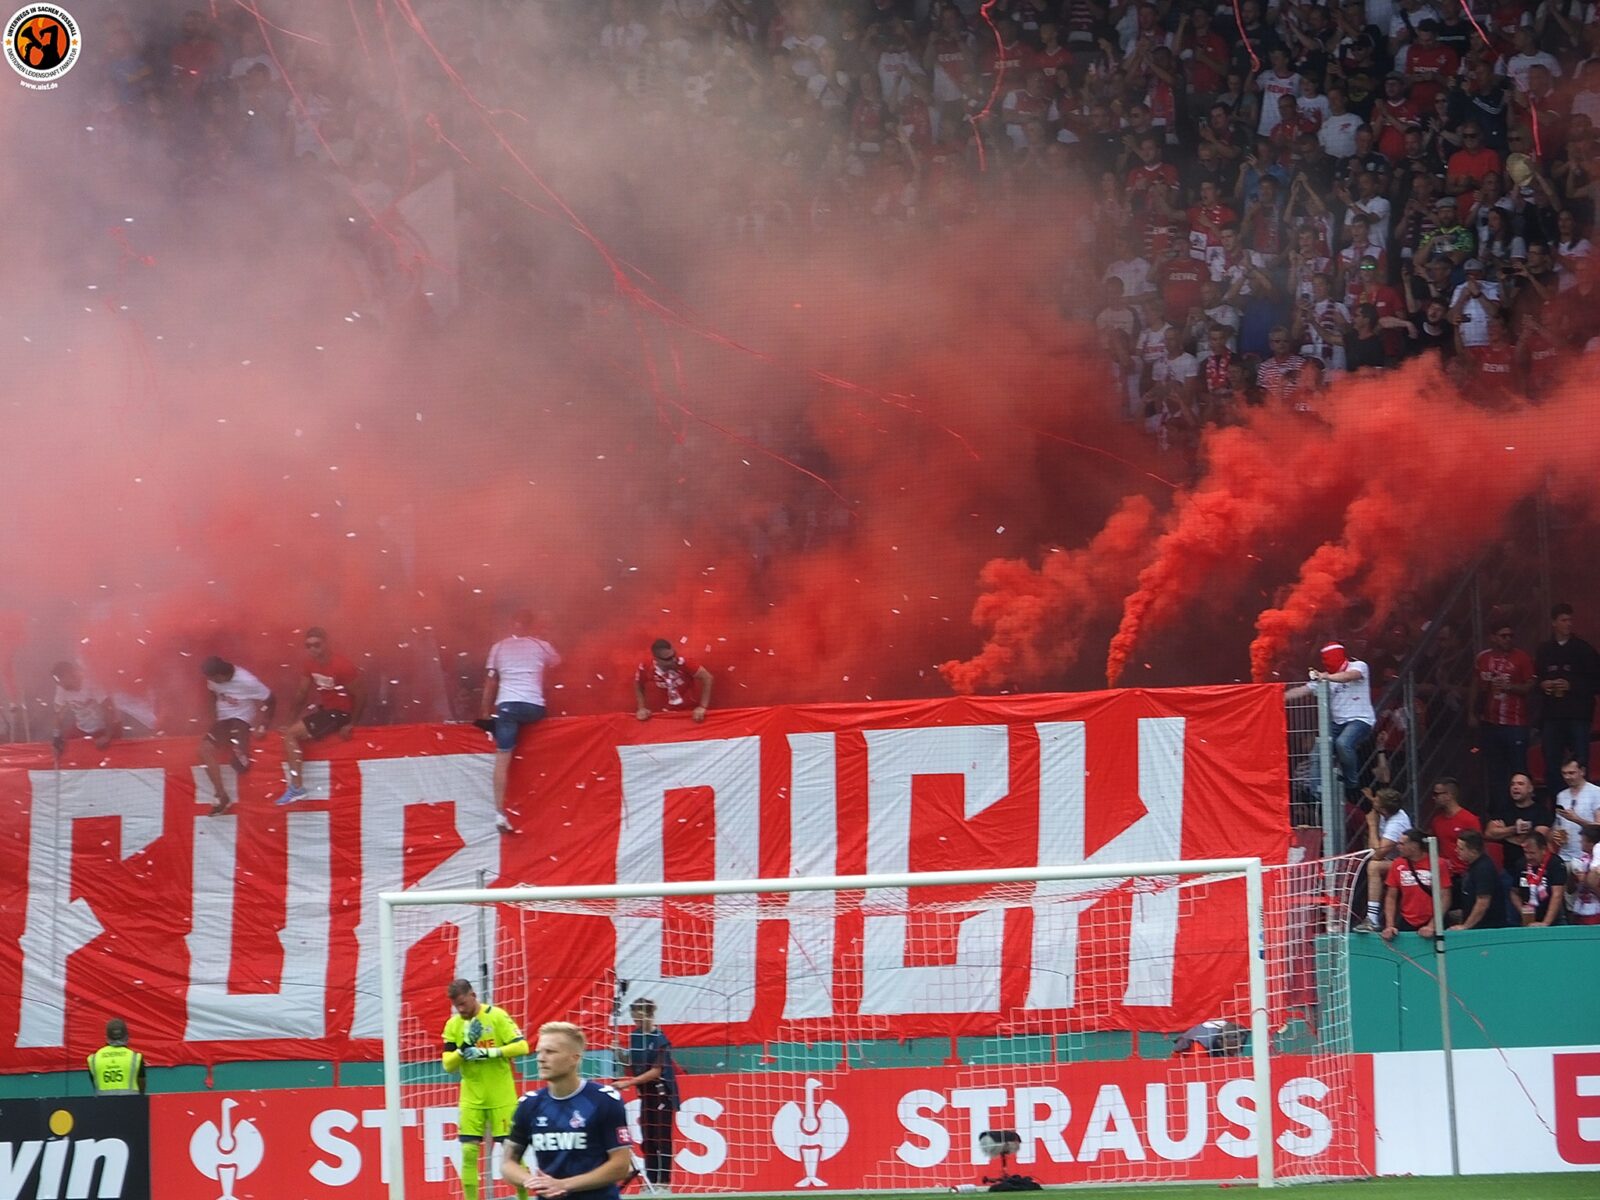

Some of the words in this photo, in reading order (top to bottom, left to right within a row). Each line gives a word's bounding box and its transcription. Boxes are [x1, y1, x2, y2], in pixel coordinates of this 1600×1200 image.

[15, 752, 501, 1048] FÜR
[611, 716, 1187, 1026] DICH
[103, 1070, 124, 1083] 605
[531, 1131, 588, 1152] REWE
[895, 1076, 1334, 1168] STRAUSS
